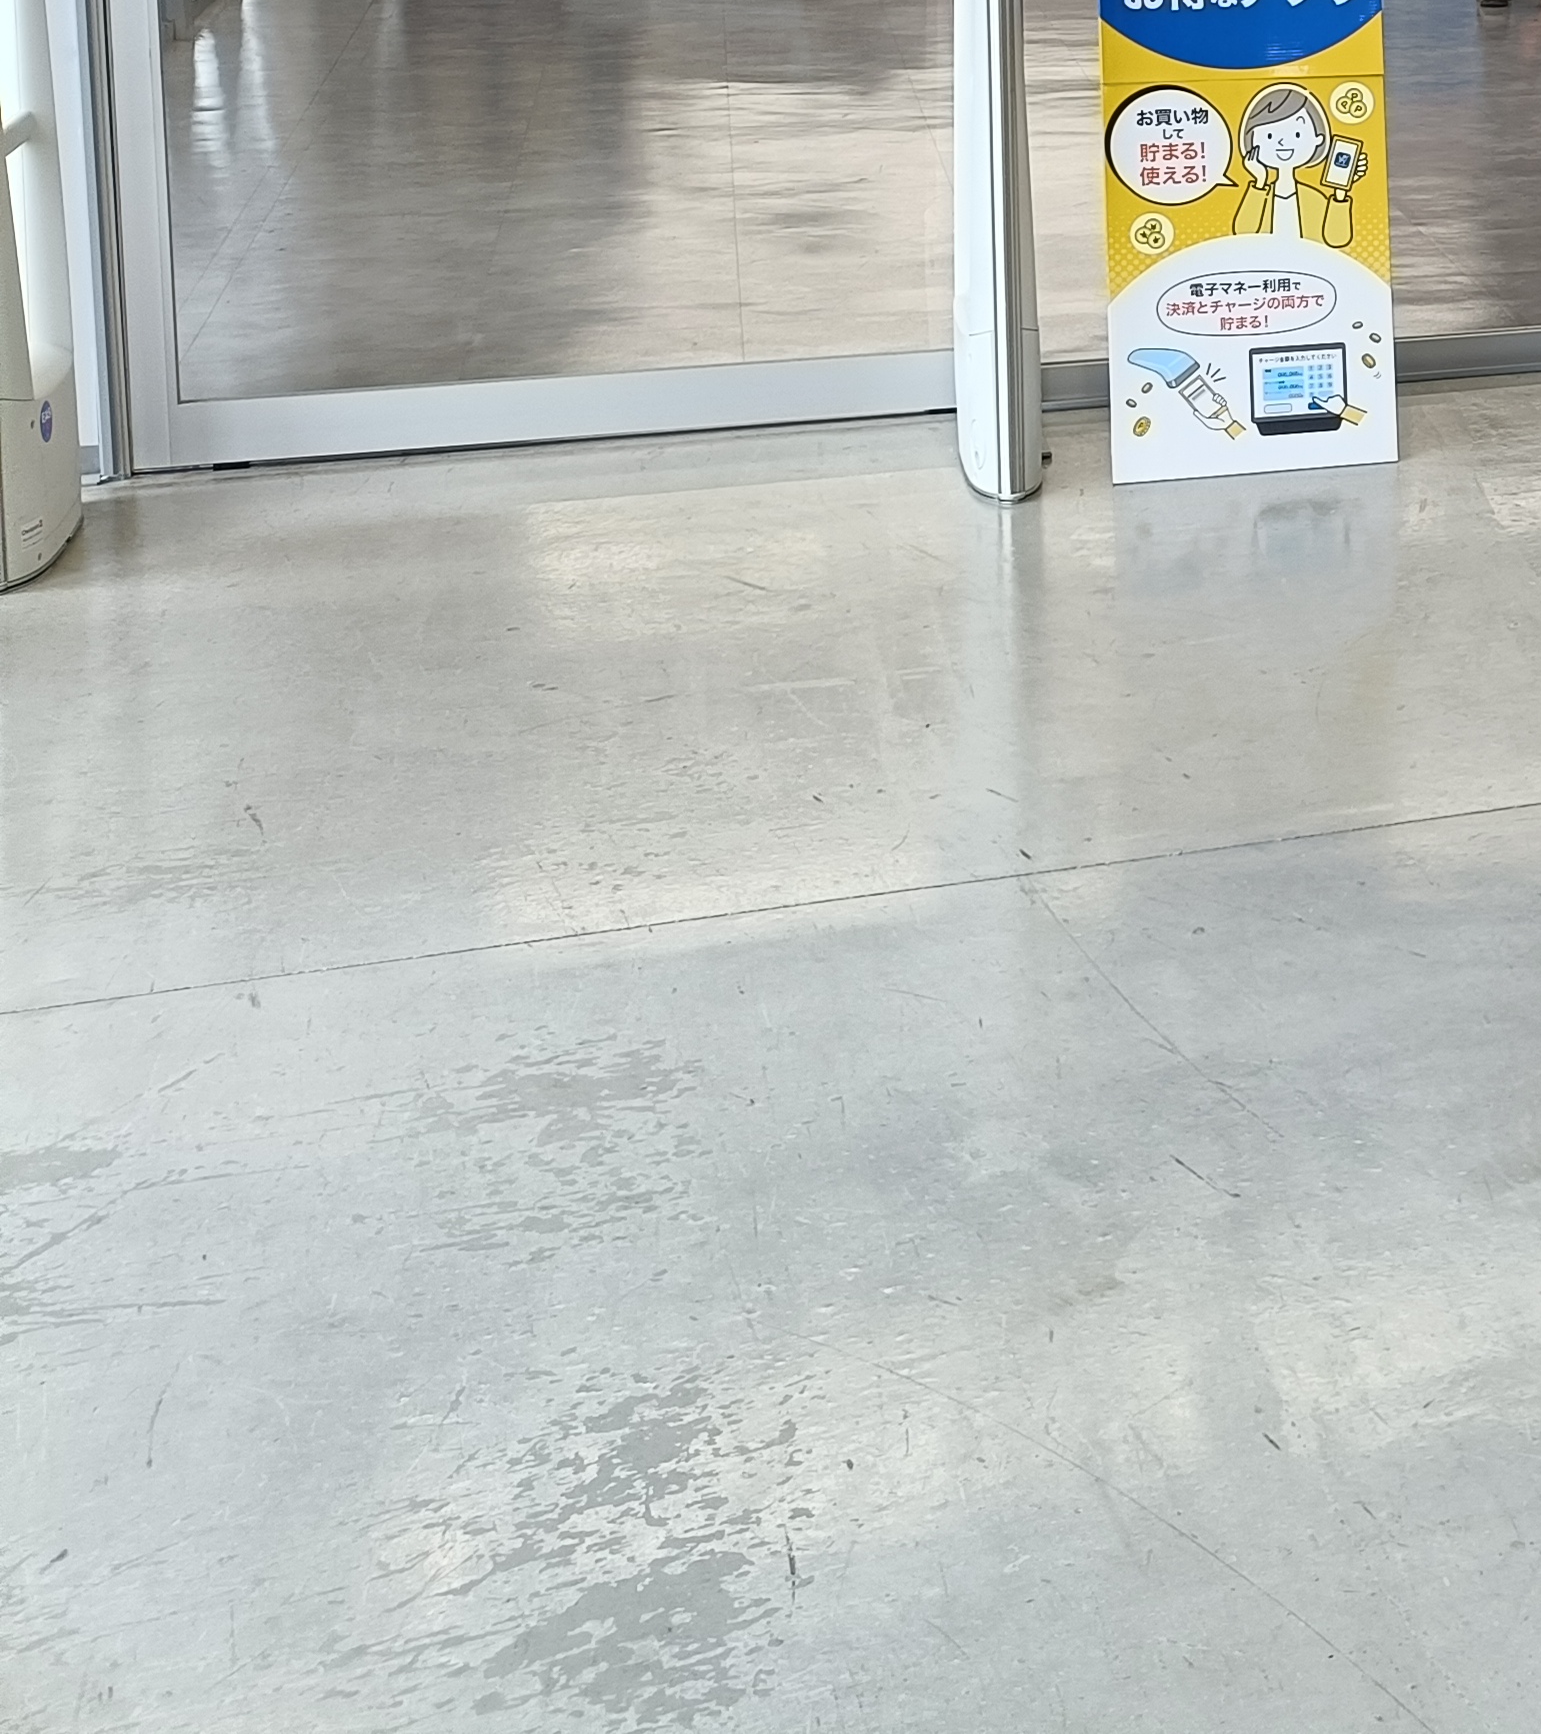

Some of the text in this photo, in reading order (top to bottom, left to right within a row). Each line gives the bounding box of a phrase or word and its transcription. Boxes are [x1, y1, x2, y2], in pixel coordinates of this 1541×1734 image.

[1135, 108, 1209, 126] お買い物
[1162, 128, 1185, 140] して
[1139, 142, 1206, 162] 貯まる！
[1139, 165, 1207, 186] 使える！
[1189, 278, 1301, 297] 電子マネー利用で
[1165, 295, 1325, 317] 決済とチャージの両方で
[1219, 315, 1269, 331] 貯まる！
